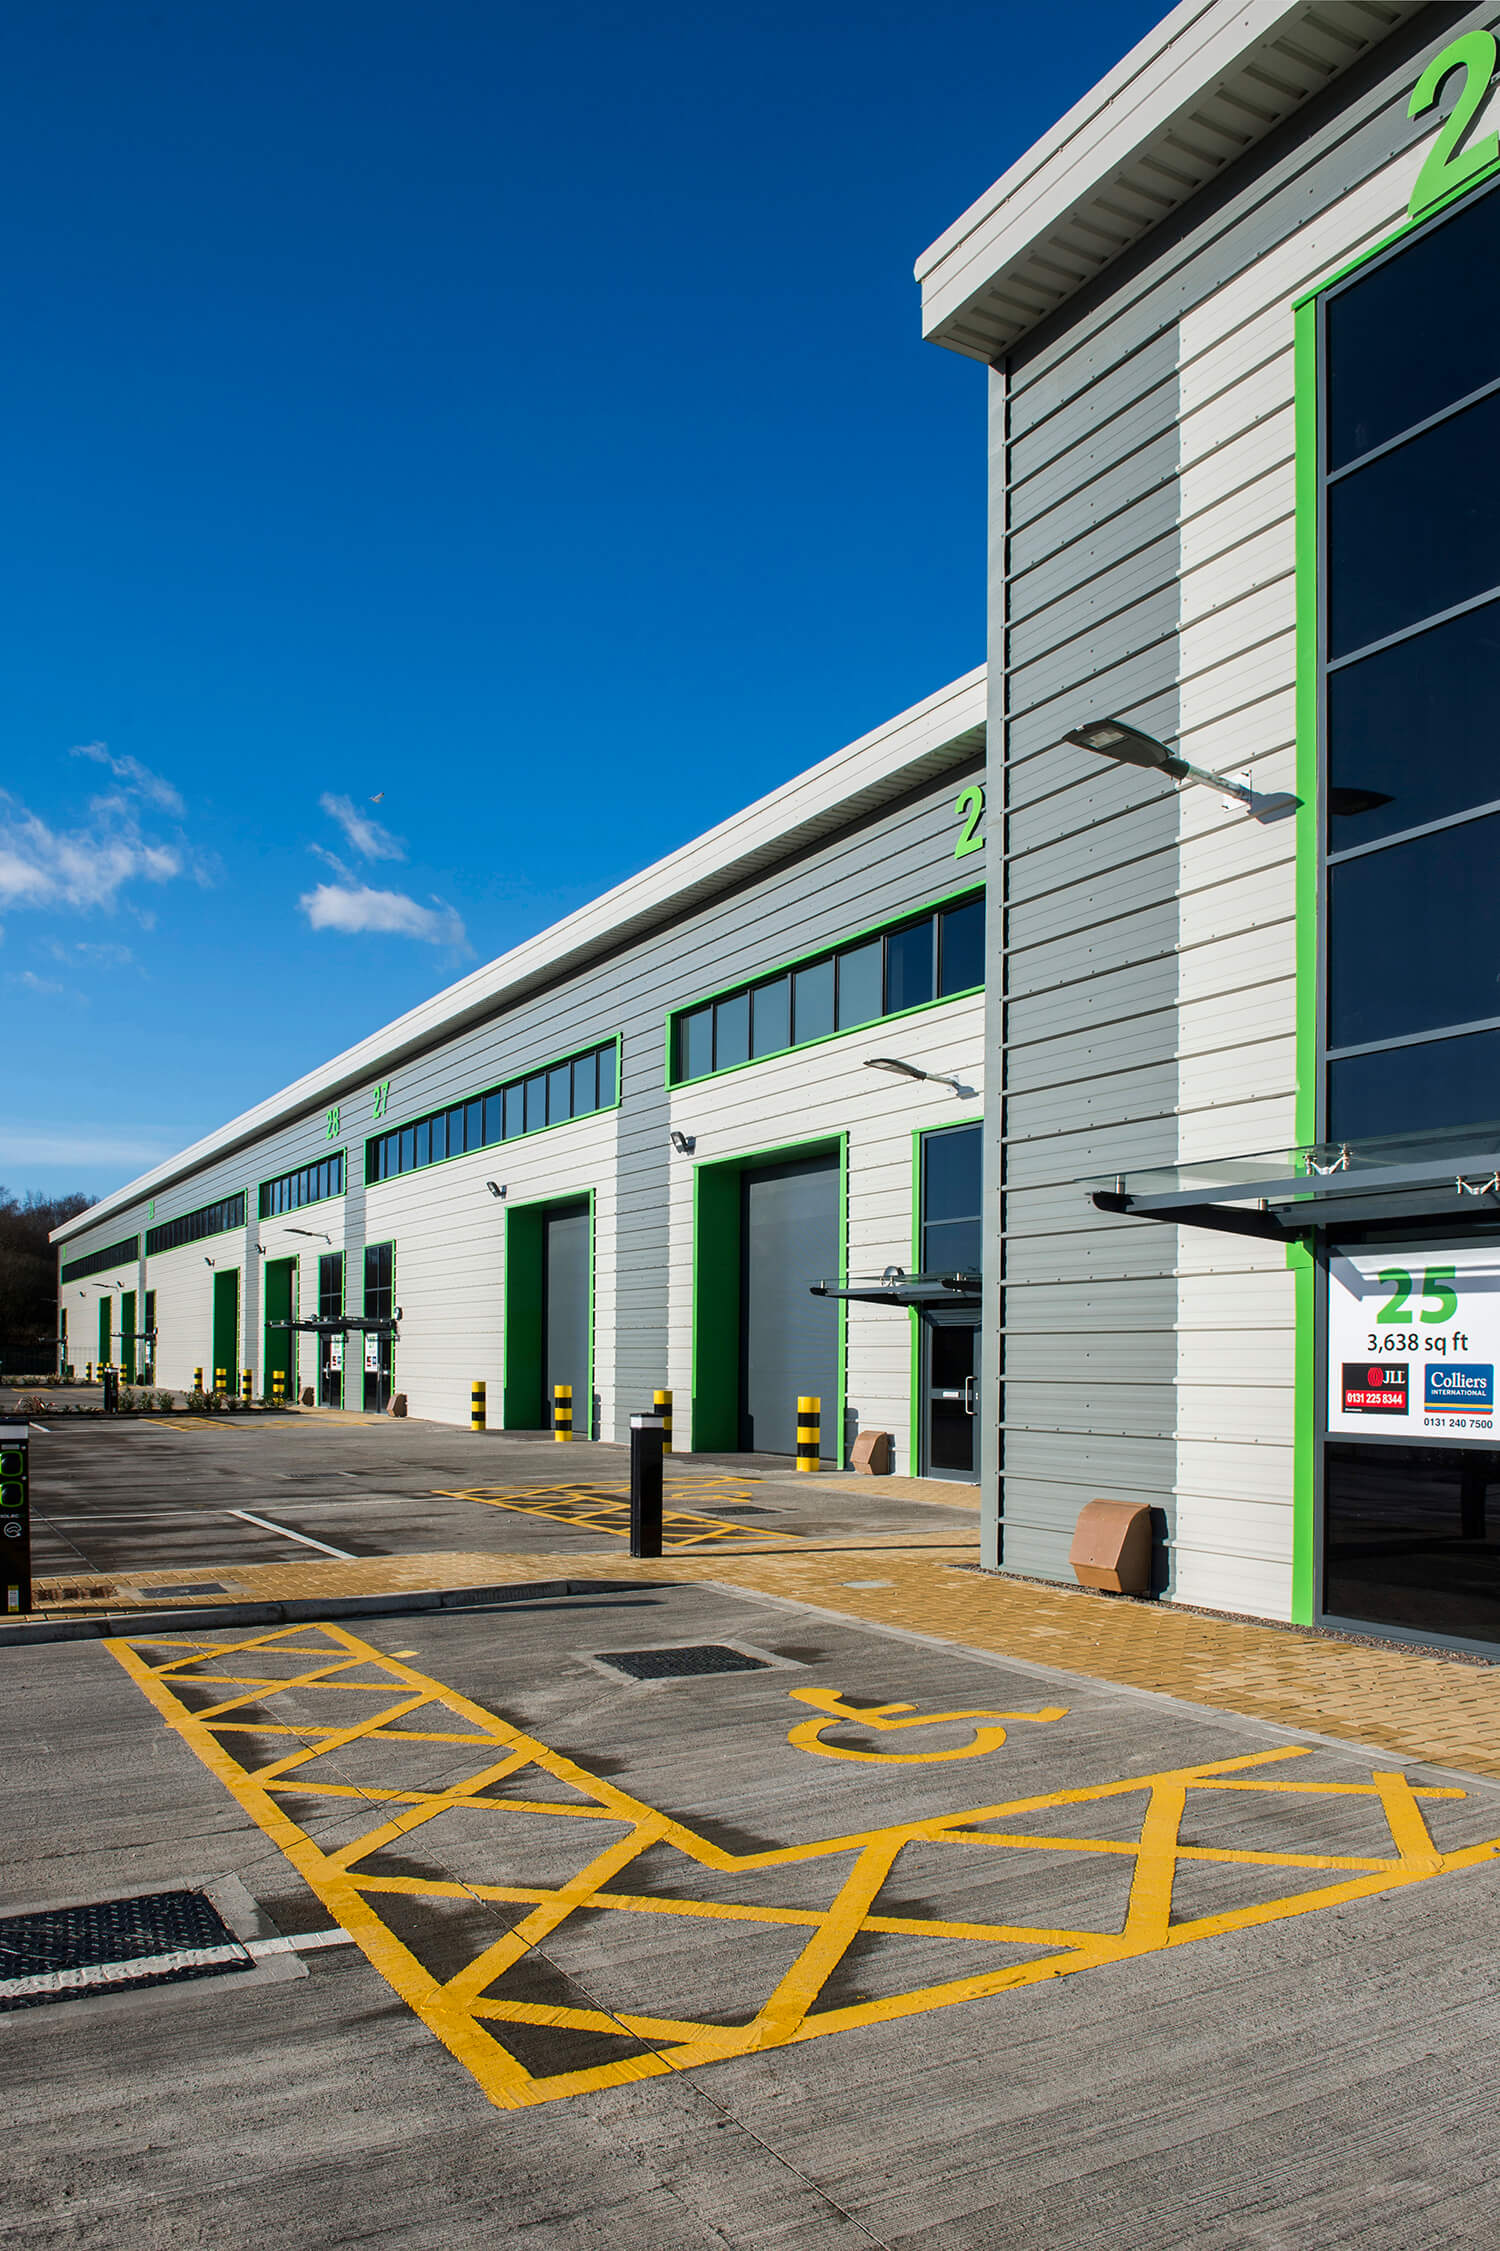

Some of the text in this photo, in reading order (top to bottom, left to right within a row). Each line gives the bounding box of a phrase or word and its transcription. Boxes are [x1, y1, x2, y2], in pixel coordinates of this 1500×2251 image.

[373, 1080, 390, 1119] 27
[326, 1107, 340, 1140] 28
[1376, 1265, 1458, 1324] 25
[1367, 1331, 1468, 1356] 3,638 sq ft
[1383, 1370, 1406, 1384] JLL
[1430, 1371, 1488, 1389] Colliers
[1347, 1392, 1403, 1406] 0131 225 8344
[1431, 1389, 1487, 1397] INTERNATIONAL
[1424, 1417, 1493, 1429] 0131 240 7500
